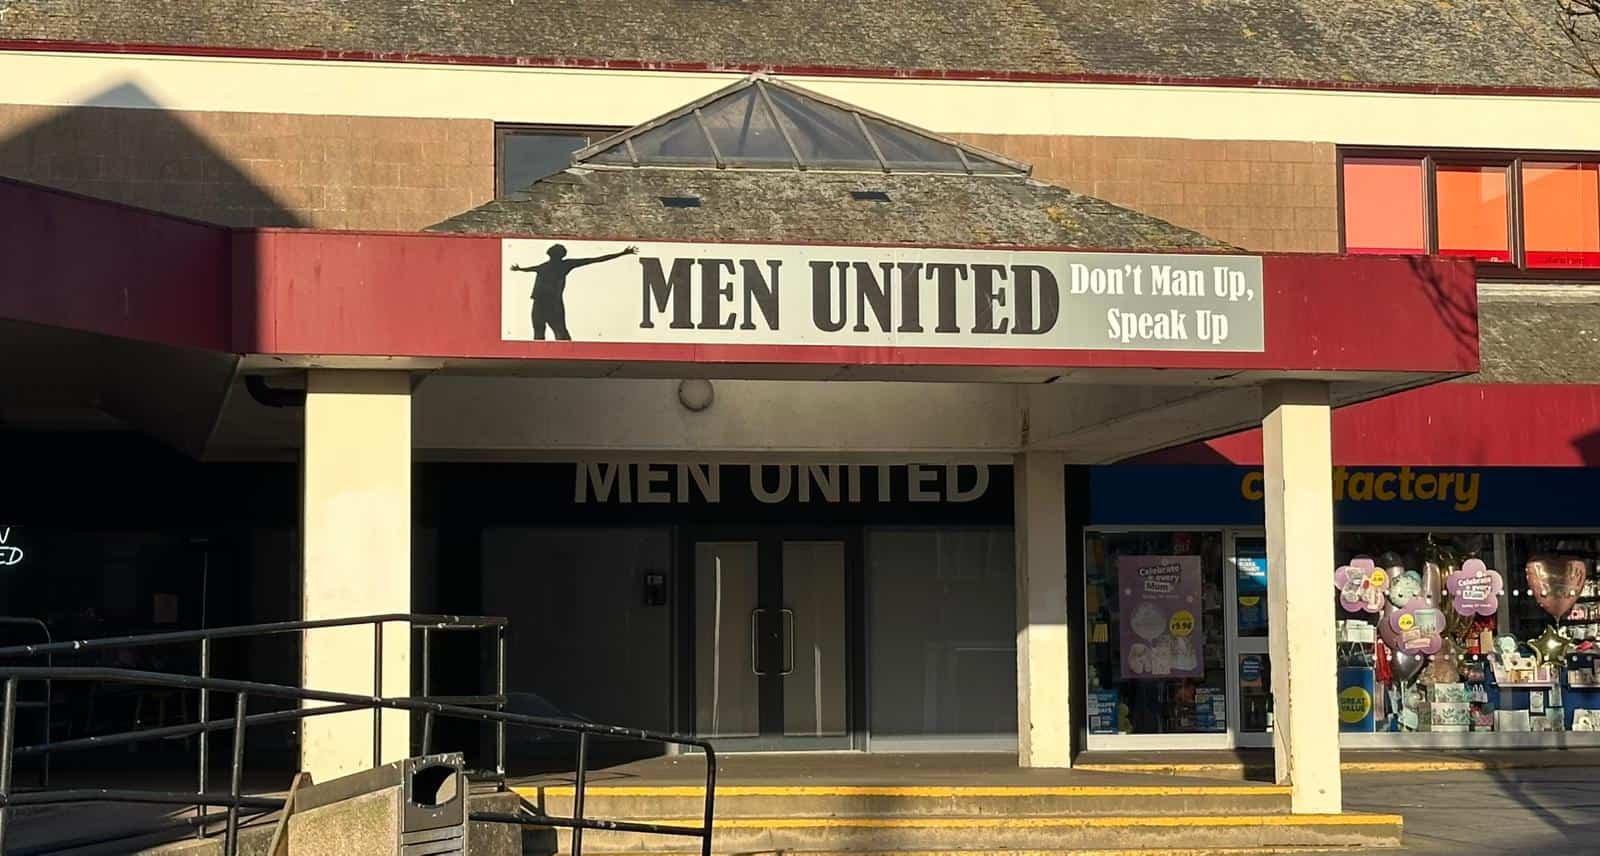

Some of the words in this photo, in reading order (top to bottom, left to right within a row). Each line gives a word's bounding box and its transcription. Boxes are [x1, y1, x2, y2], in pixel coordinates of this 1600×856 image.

[639, 257, 783, 330] MEN
[809, 260, 1060, 335] UNITED
[1070, 263, 1143, 295] Don’t
[1151, 265, 1205, 296] Man
[1213, 267, 1254, 301] Up,
[1107, 308, 1188, 343] Speak
[1196, 310, 1229, 344] Up
[575, 464, 720, 504] MEN
[750, 464, 990, 504] UNITED
